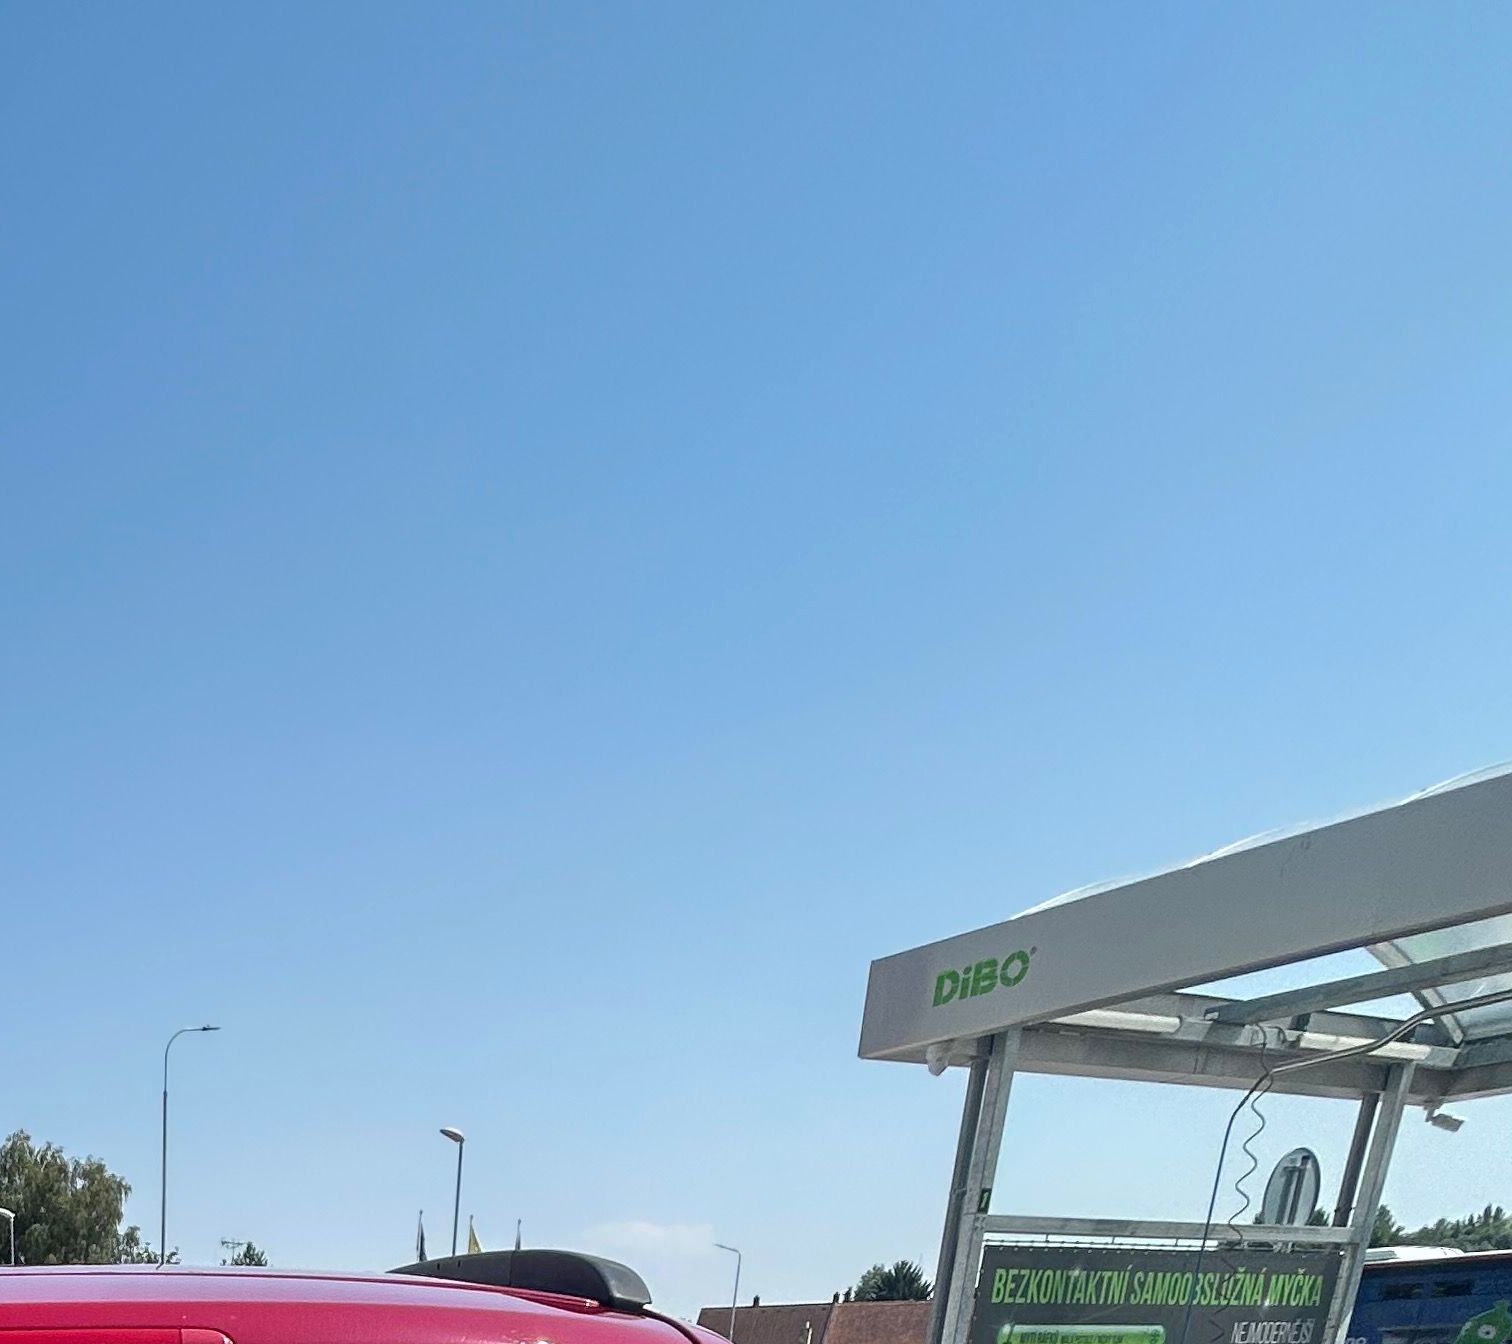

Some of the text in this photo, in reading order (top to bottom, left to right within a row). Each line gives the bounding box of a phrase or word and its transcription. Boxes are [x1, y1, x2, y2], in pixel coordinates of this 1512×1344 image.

[991, 1264, 1132, 1306] BEZKONTAKTNÍ
[1267, 1268, 1324, 1307] MYČKA
[1230, 1318, 1316, 1344] NEJMODERNĚJŠÍ
